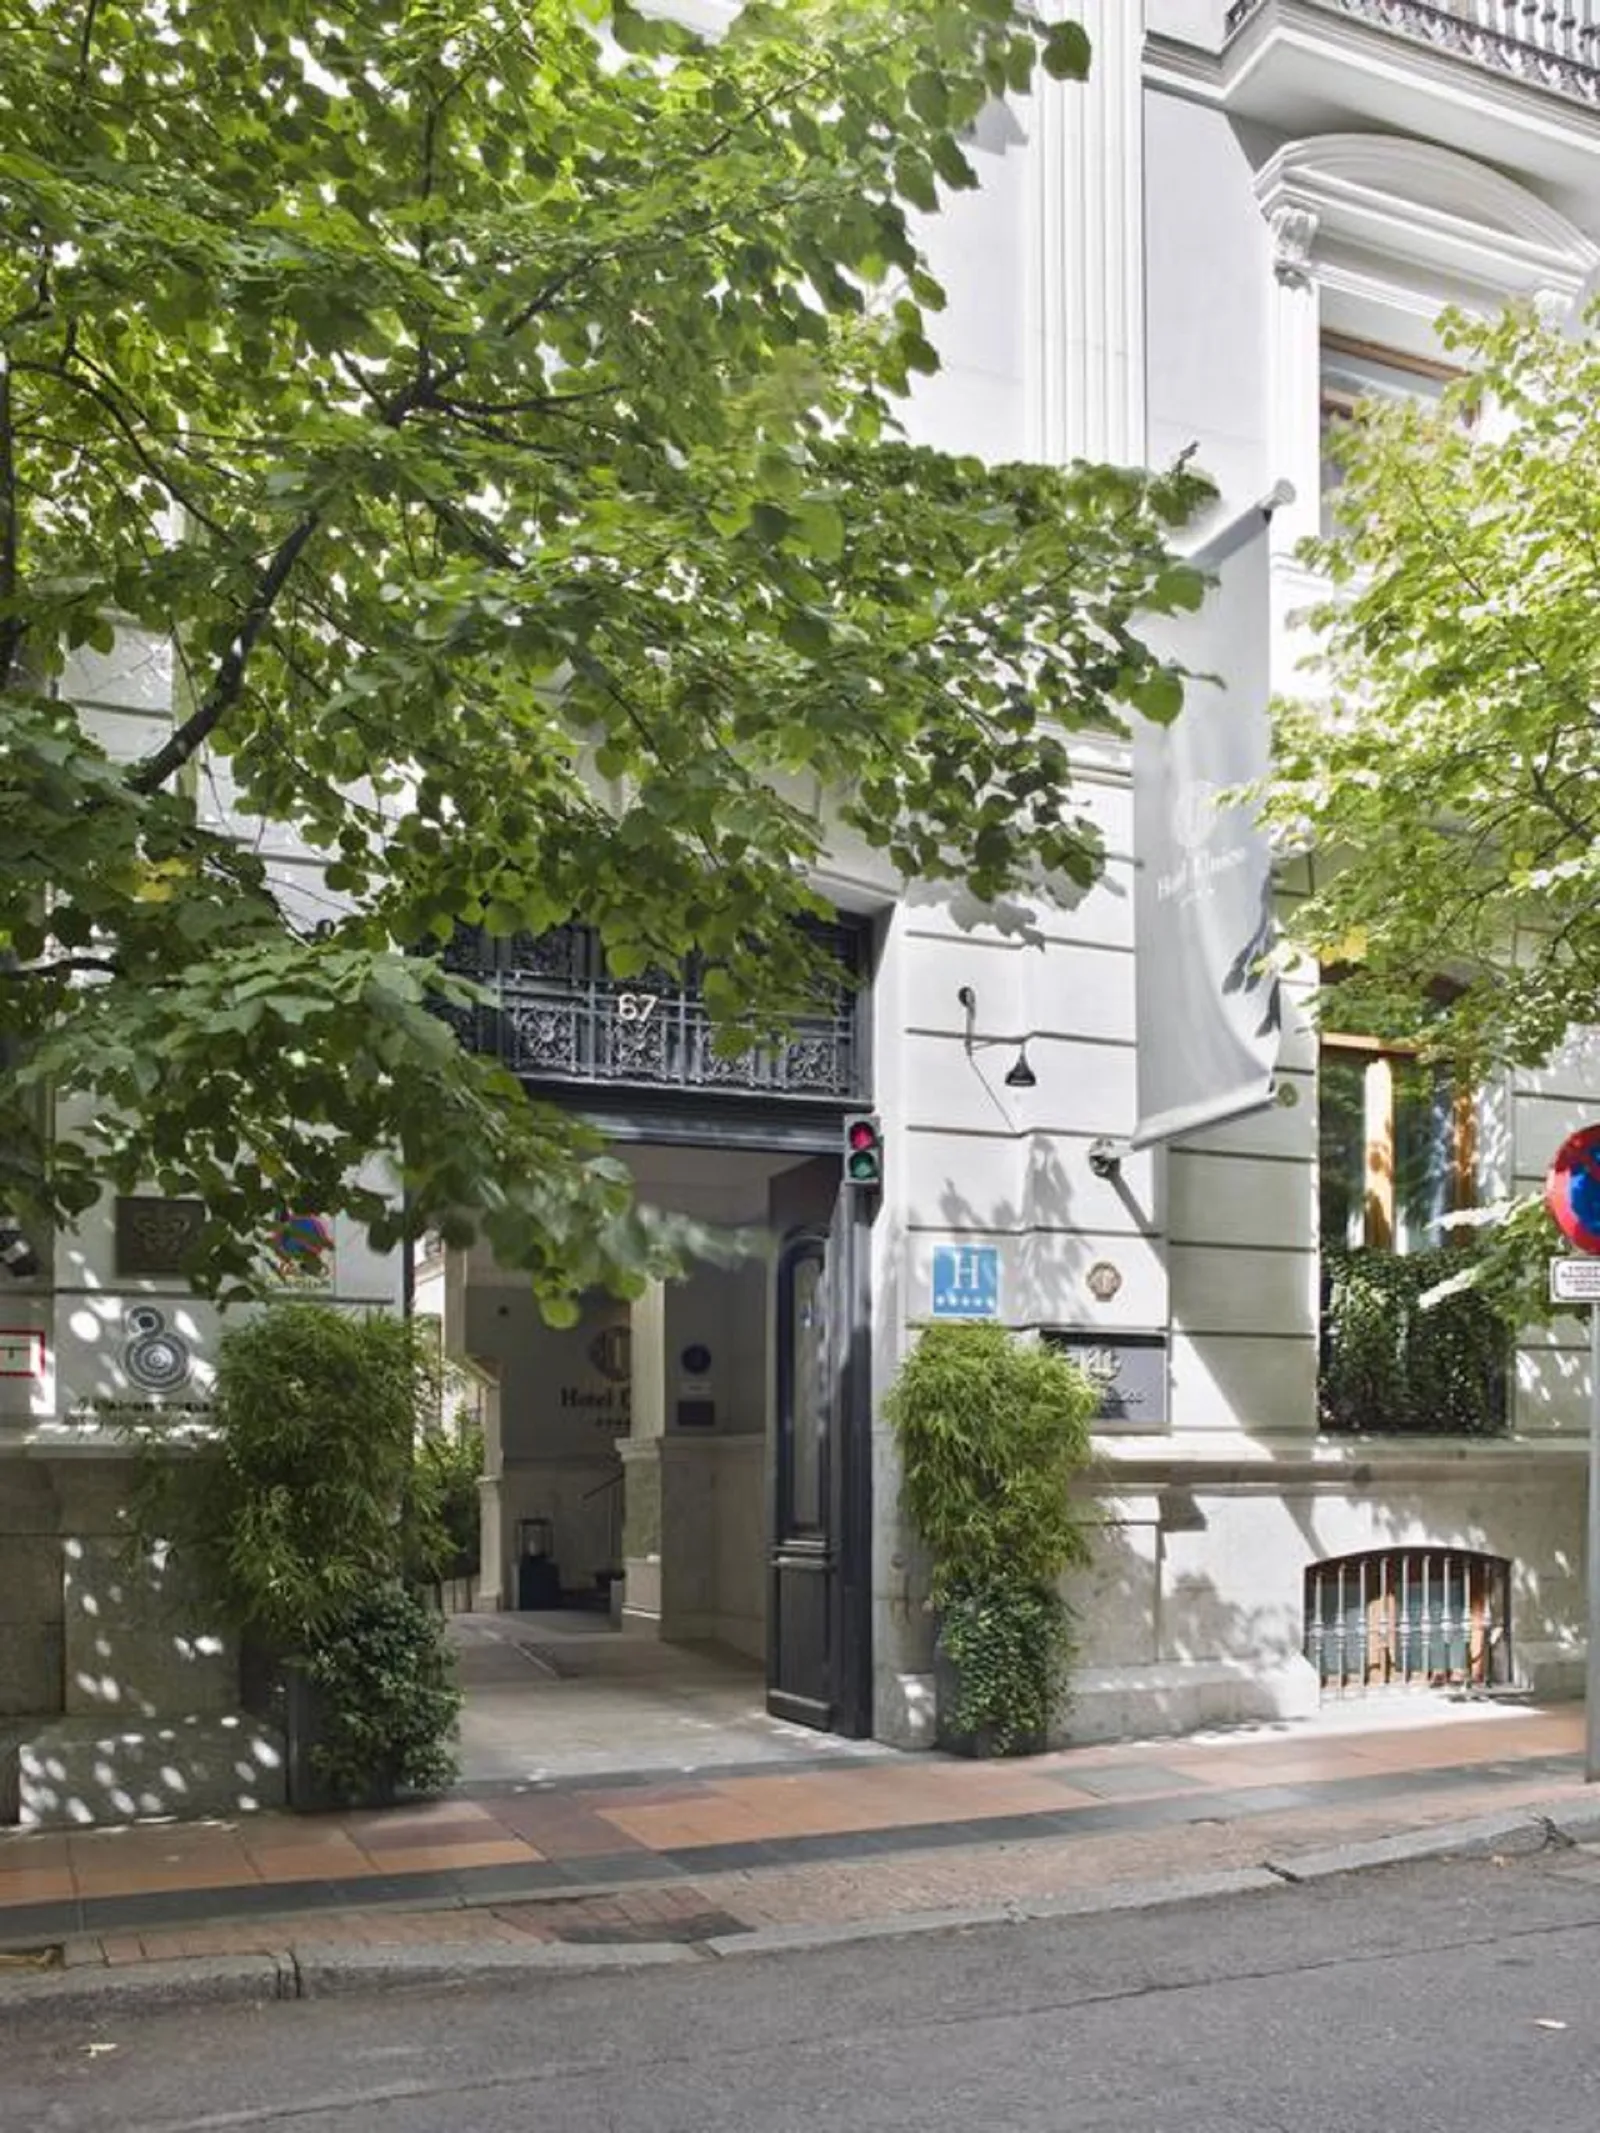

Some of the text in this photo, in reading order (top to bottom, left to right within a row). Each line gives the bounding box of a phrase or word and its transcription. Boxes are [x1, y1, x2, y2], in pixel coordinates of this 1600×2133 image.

[618, 993, 658, 1022] 67
[951, 1252, 980, 1289] H
[560, 1386, 613, 1408] Hotel
